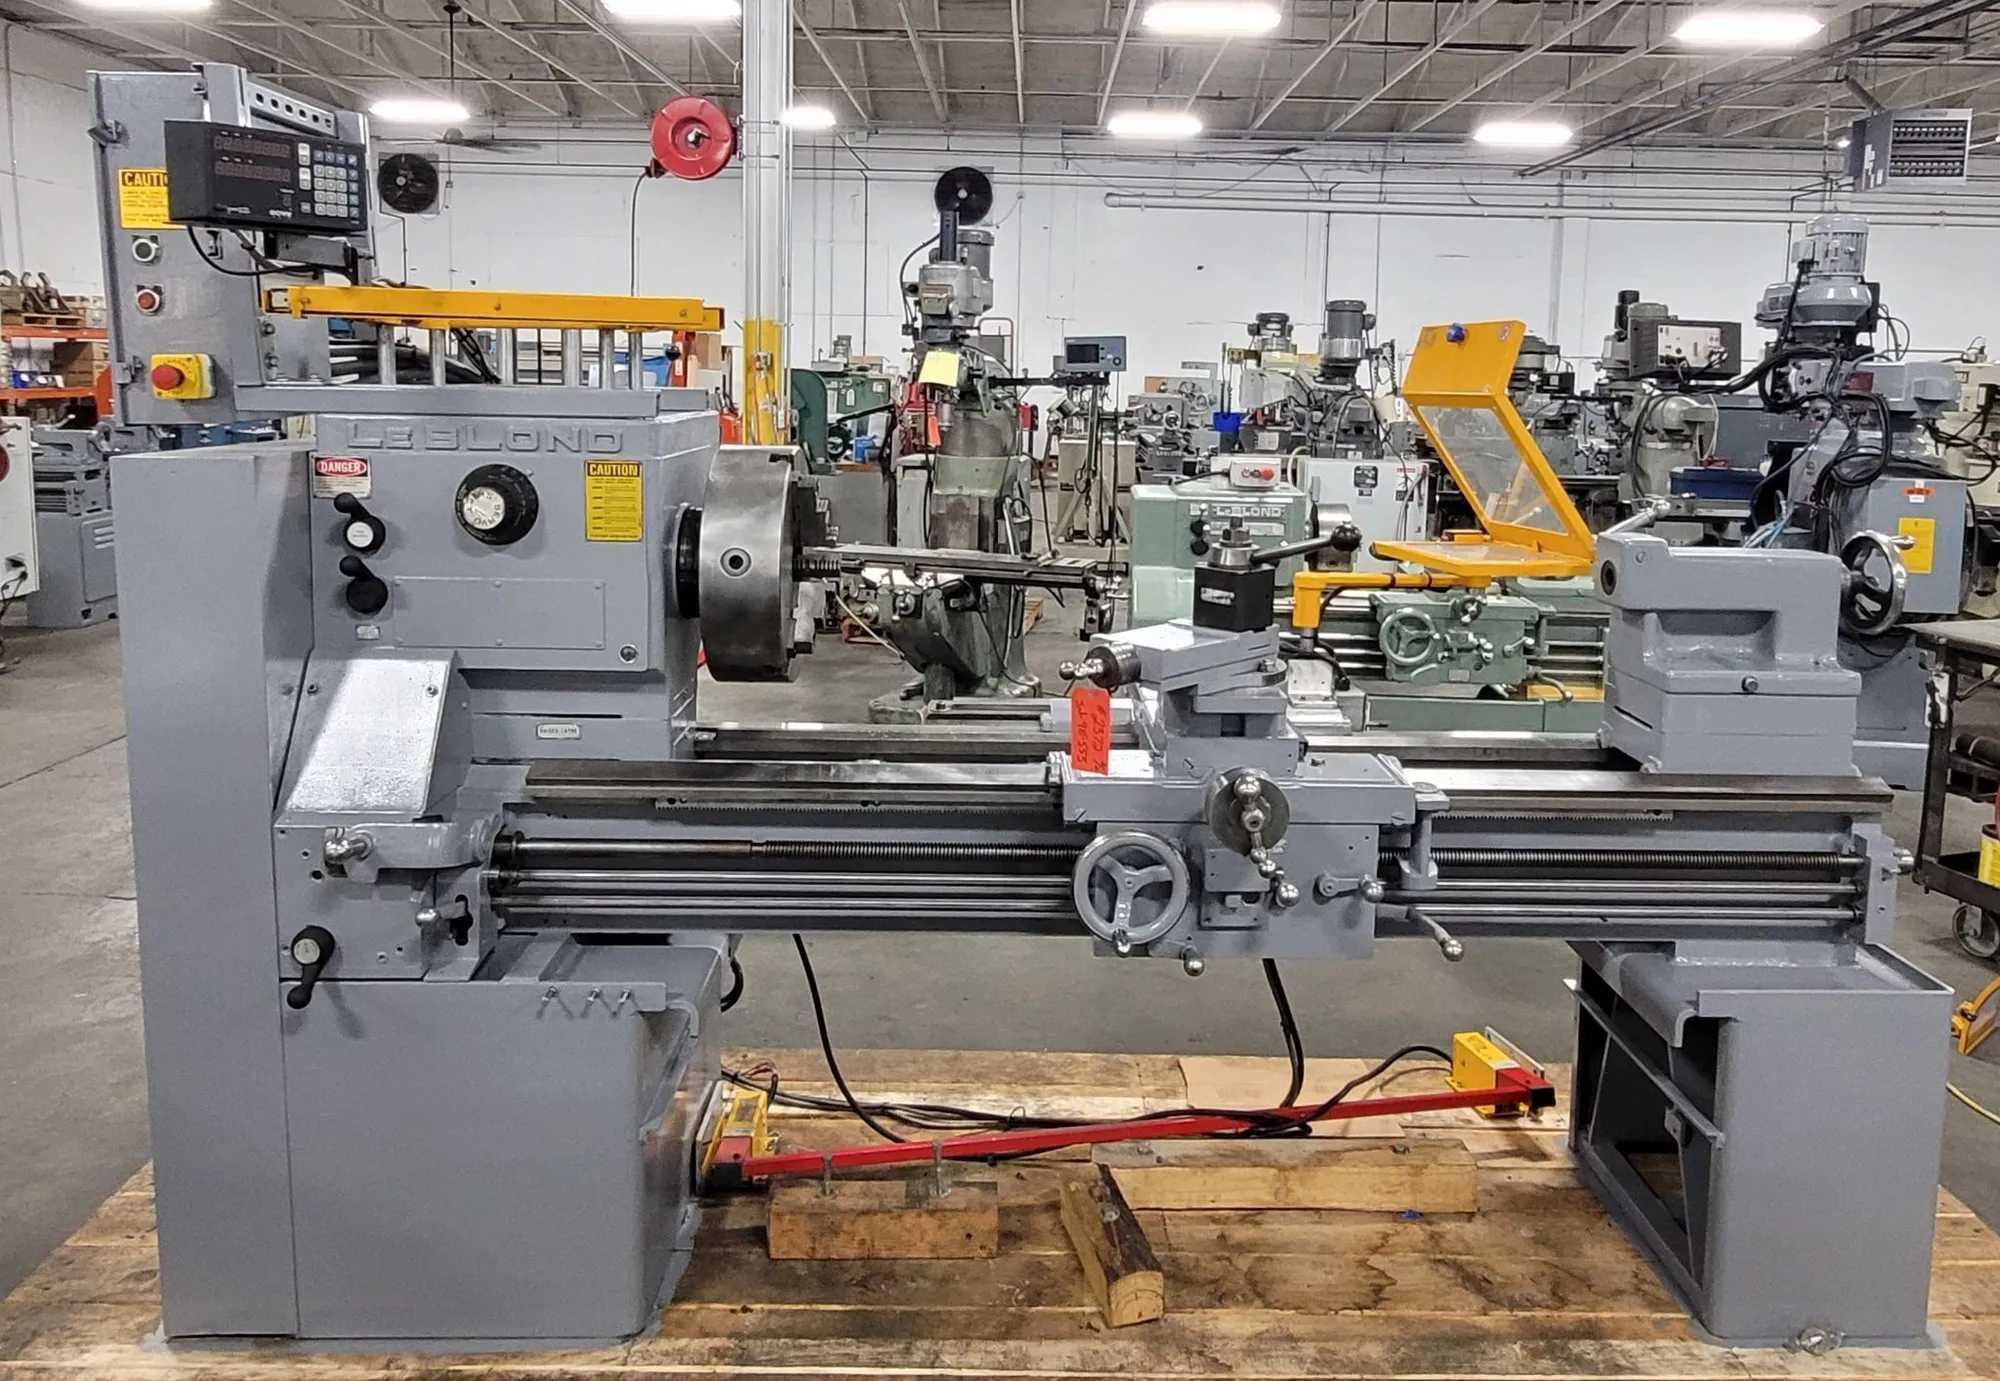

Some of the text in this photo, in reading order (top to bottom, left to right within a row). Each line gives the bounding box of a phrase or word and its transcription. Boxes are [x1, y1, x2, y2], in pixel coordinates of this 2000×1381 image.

[124, 172, 168, 186] CAUTI
[320, 461, 362, 473] DANGER
[589, 463, 638, 476] CAUTION
